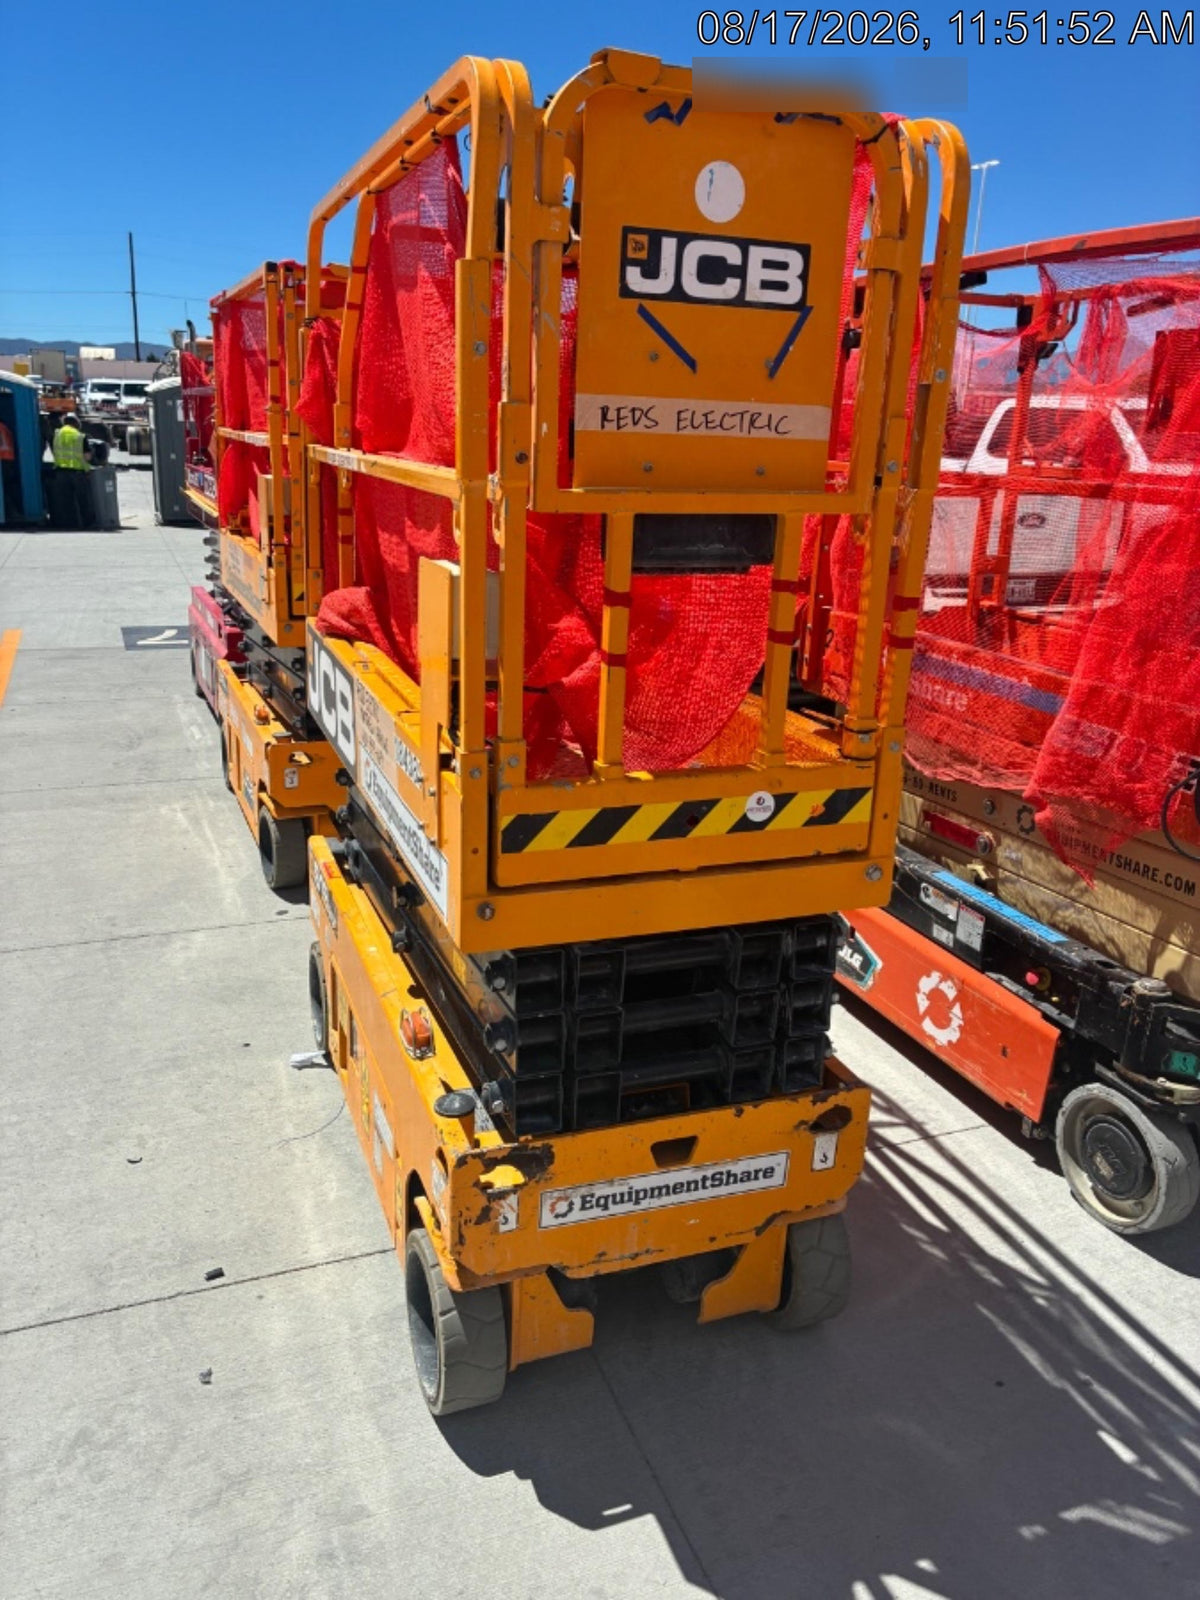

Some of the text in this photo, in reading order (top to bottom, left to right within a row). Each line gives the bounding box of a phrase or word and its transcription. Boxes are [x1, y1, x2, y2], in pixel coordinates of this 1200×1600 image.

[625, 236, 804, 305] JCB
[599, 404, 792, 435] REDS ELECTRIC
[308, 640, 356, 766] JCB
[578, 1165, 775, 1212] EquipmentShare
